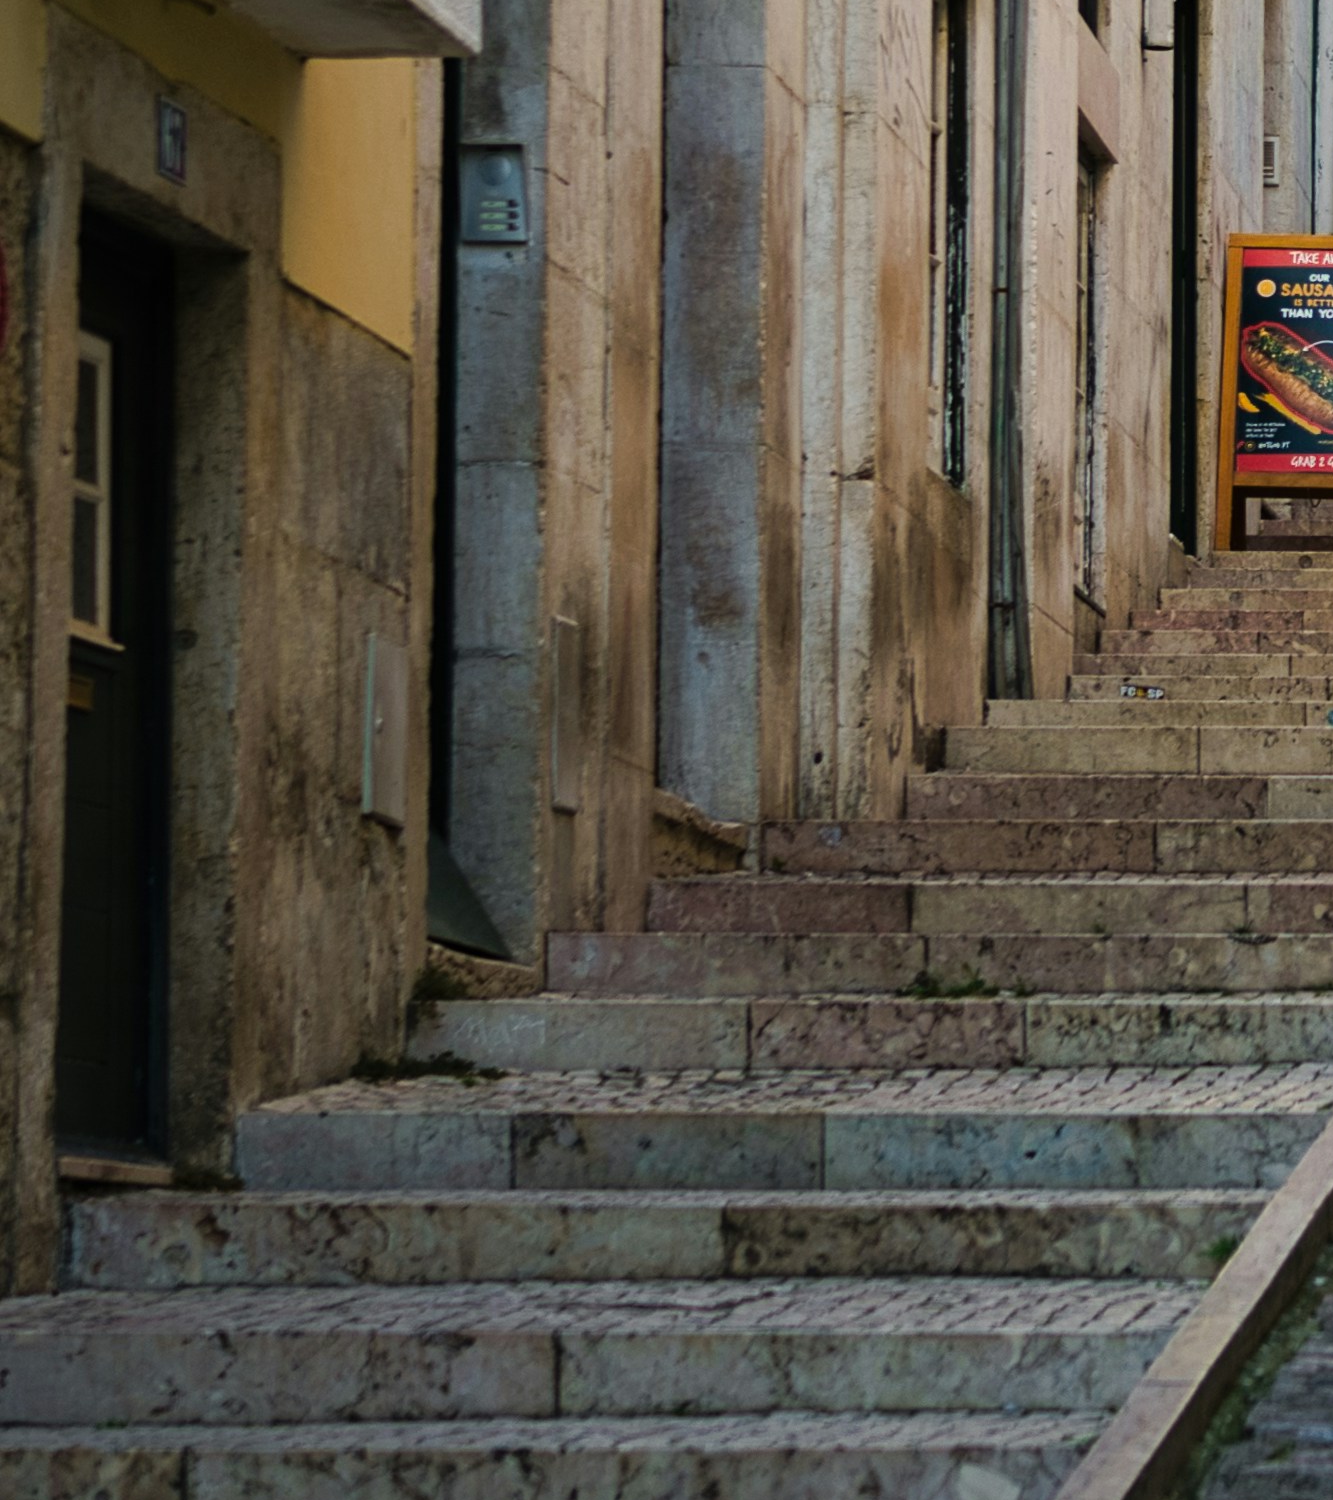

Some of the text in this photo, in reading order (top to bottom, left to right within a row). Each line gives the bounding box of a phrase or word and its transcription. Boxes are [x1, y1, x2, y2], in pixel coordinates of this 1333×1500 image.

[1290, 251, 1319, 264] TAKE
[1309, 273, 1331, 282] OUR
[1294, 299, 1302, 307] IS
[1280, 308, 1313, 318] THAN
[1290, 457, 1316, 468] GRAB
[1318, 456, 1325, 466] 2
